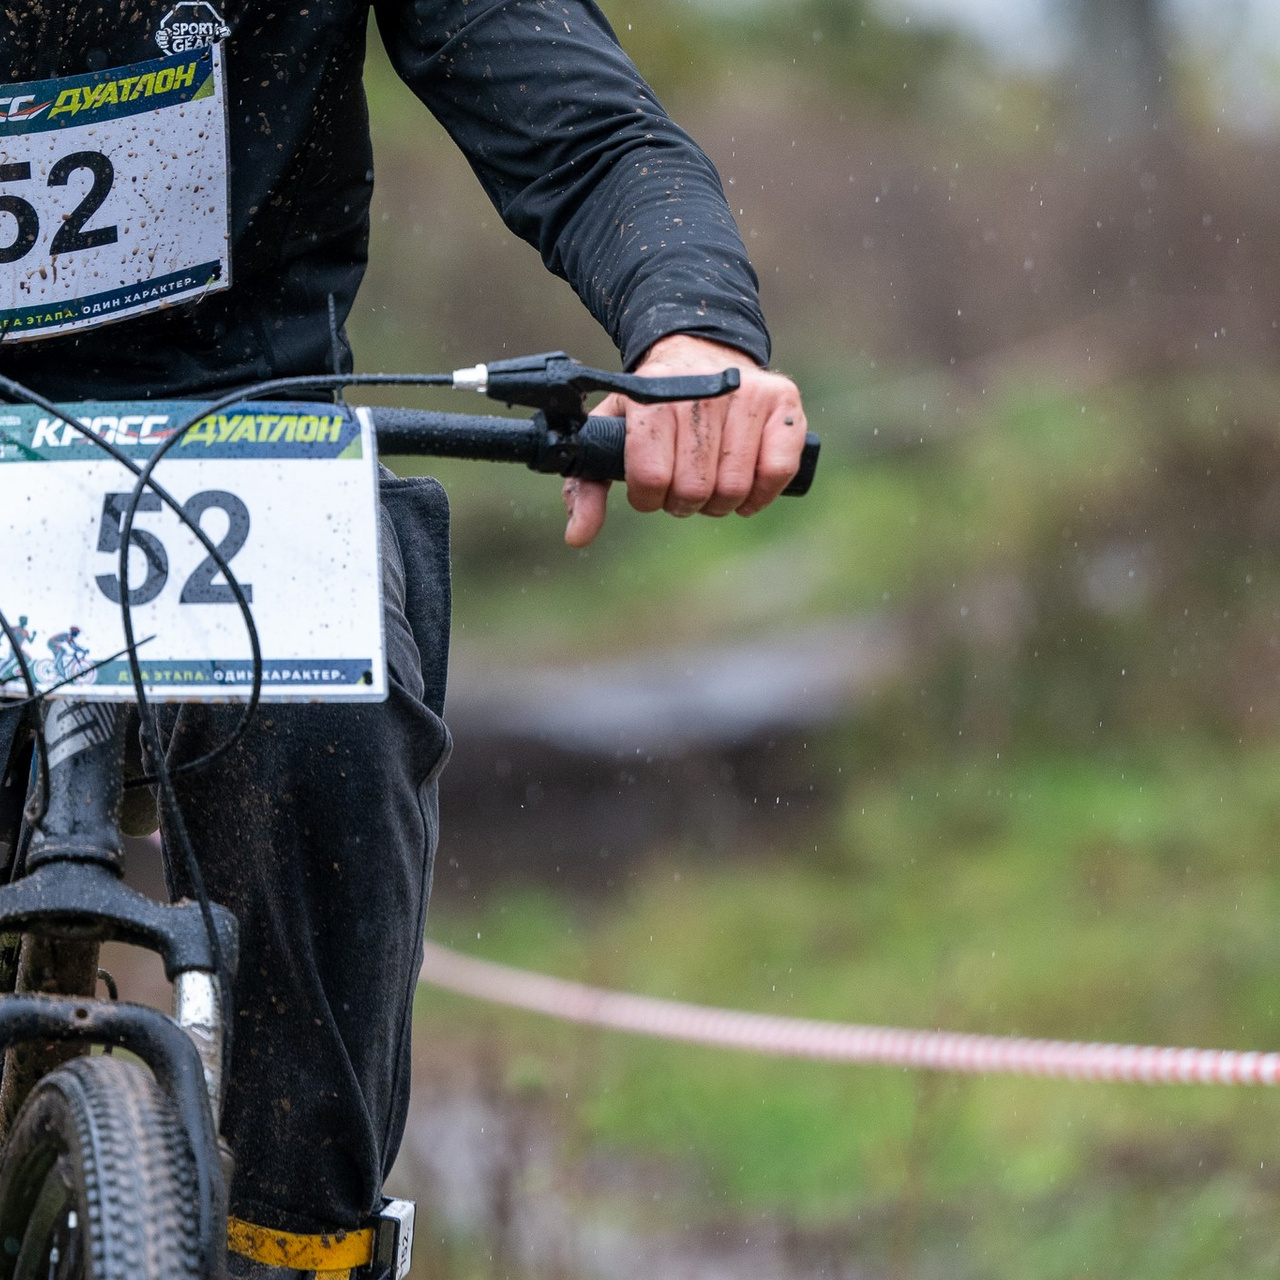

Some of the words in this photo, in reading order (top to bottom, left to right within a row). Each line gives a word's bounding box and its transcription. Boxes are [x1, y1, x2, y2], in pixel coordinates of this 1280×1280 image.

[47, 62, 197, 119] ДУАТЛОН
[26, 310, 79, 325] ЭТАПА.
[82, 298, 120, 314] ОДИН
[124, 277, 197, 303] ХАРАКТЕР.
[31, 414, 170, 448] КРОСС
[180, 415, 343, 448] ДУАТЛОН
[94, 489, 253, 606] 52
[118, 670, 150, 682] ДА
[154, 669, 209, 681] ЭТАПА.
[261, 669, 347, 681] ХАРАКТЕР.
